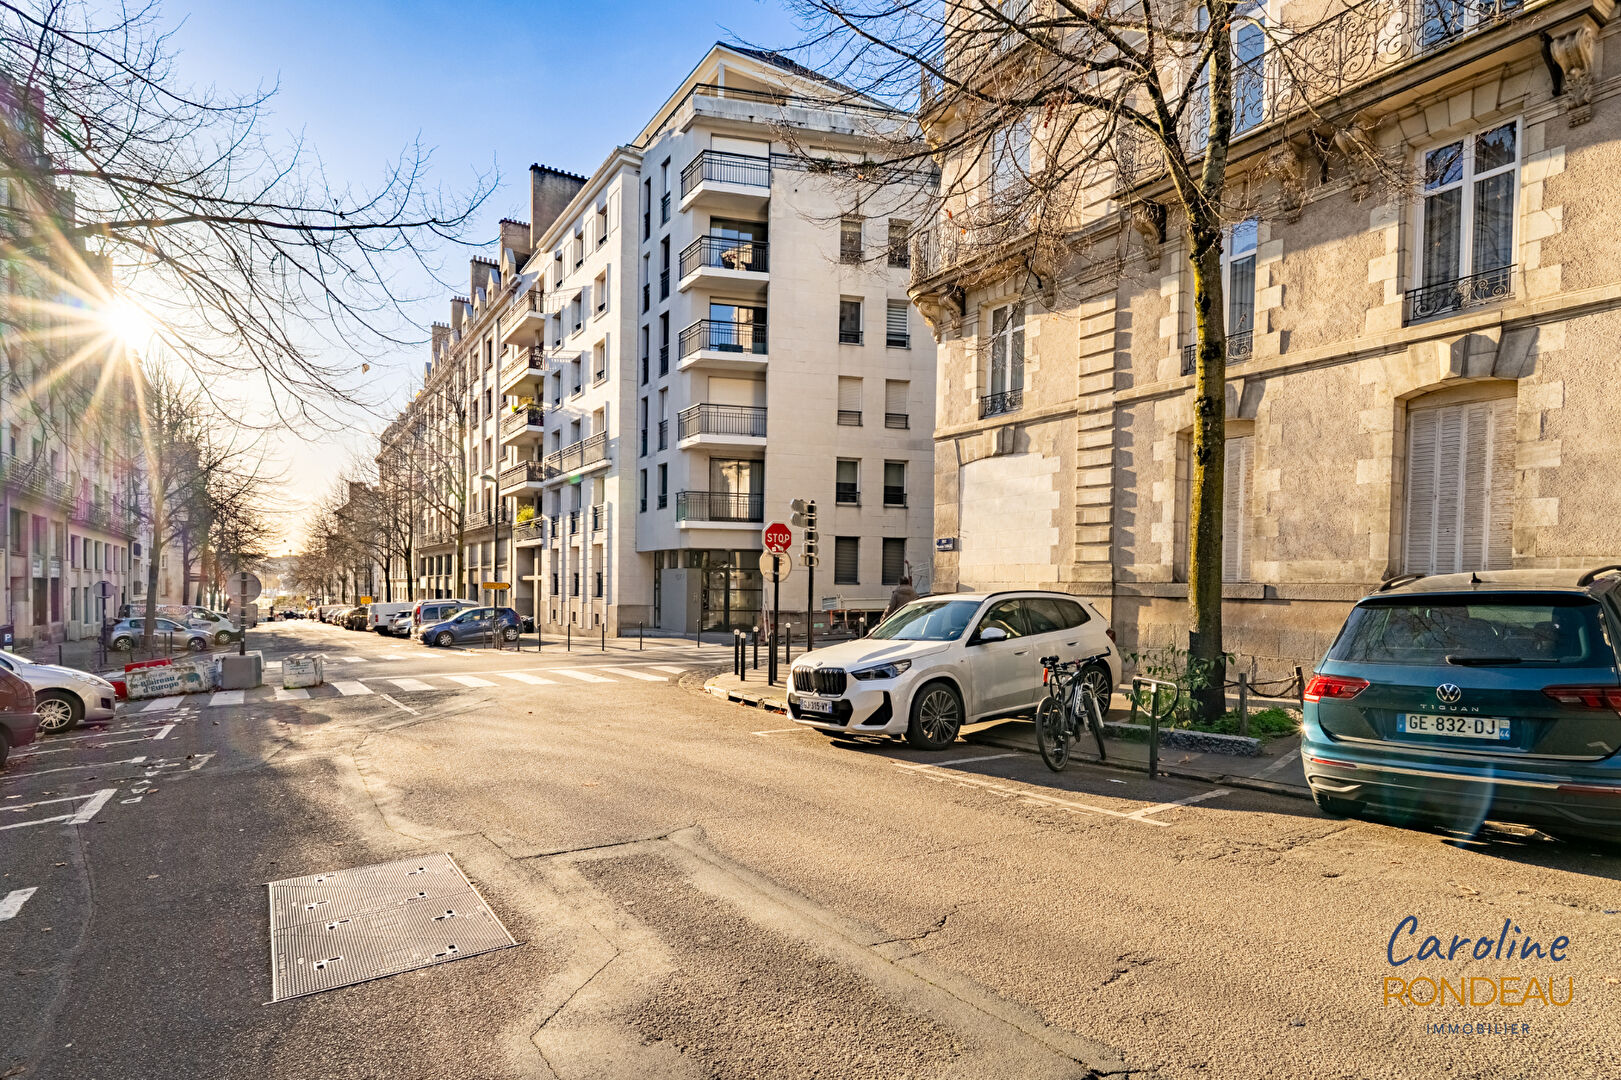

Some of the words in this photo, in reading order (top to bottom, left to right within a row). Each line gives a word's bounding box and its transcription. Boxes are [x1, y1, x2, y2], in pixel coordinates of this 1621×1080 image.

[767, 533, 790, 543] STOP
[4, 633, 12, 641] P
[140, 676, 175, 687] Blaireau
[143, 681, 180, 693] d'Europe
[1420, 704, 1480, 712] TIGUAN
[1409, 716, 1495, 735] GE-832-DJ
[1499, 730, 1510, 738] 44
